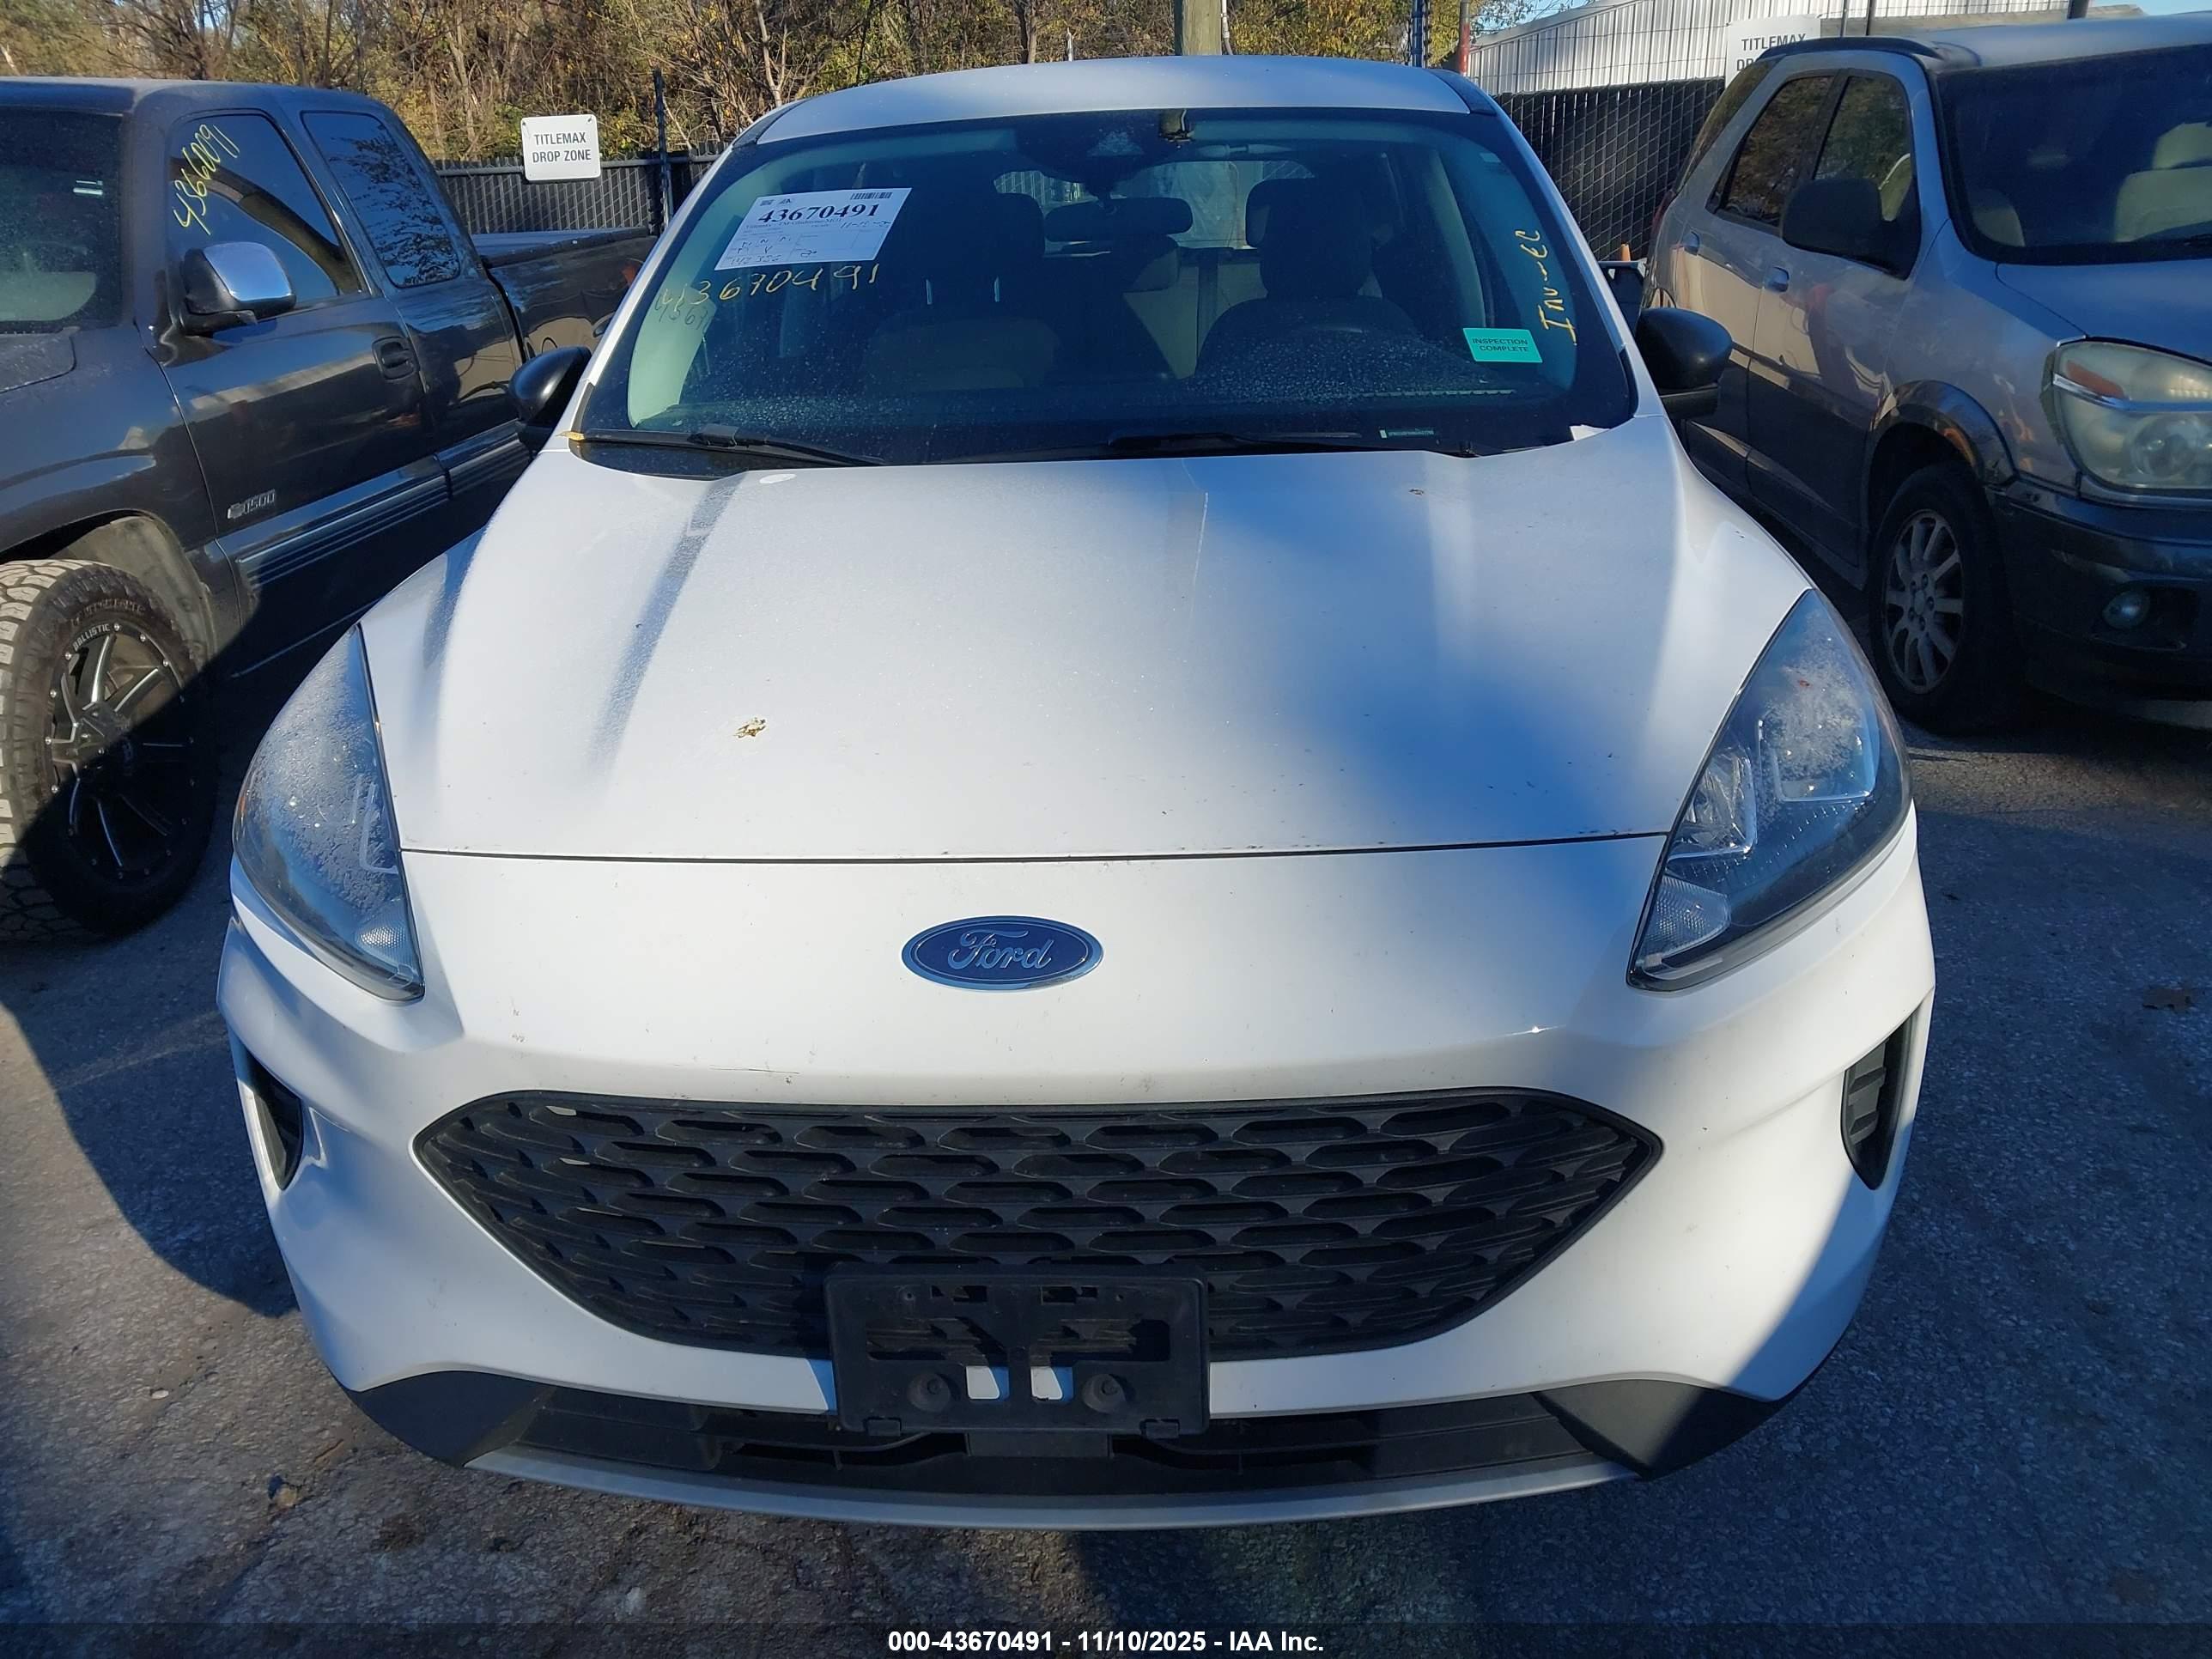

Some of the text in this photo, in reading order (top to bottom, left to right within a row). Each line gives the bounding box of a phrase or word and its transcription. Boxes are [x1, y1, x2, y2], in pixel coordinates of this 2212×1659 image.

[533, 131, 586, 145] TITLEMAX
[532, 149, 592, 163] DROP ZONE
[758, 204, 880, 223] 43670491
[660, 263, 880, 313] 43670491
[72, 623, 110, 652] BALLISTIC
[948, 929, 1054, 969] Ford
